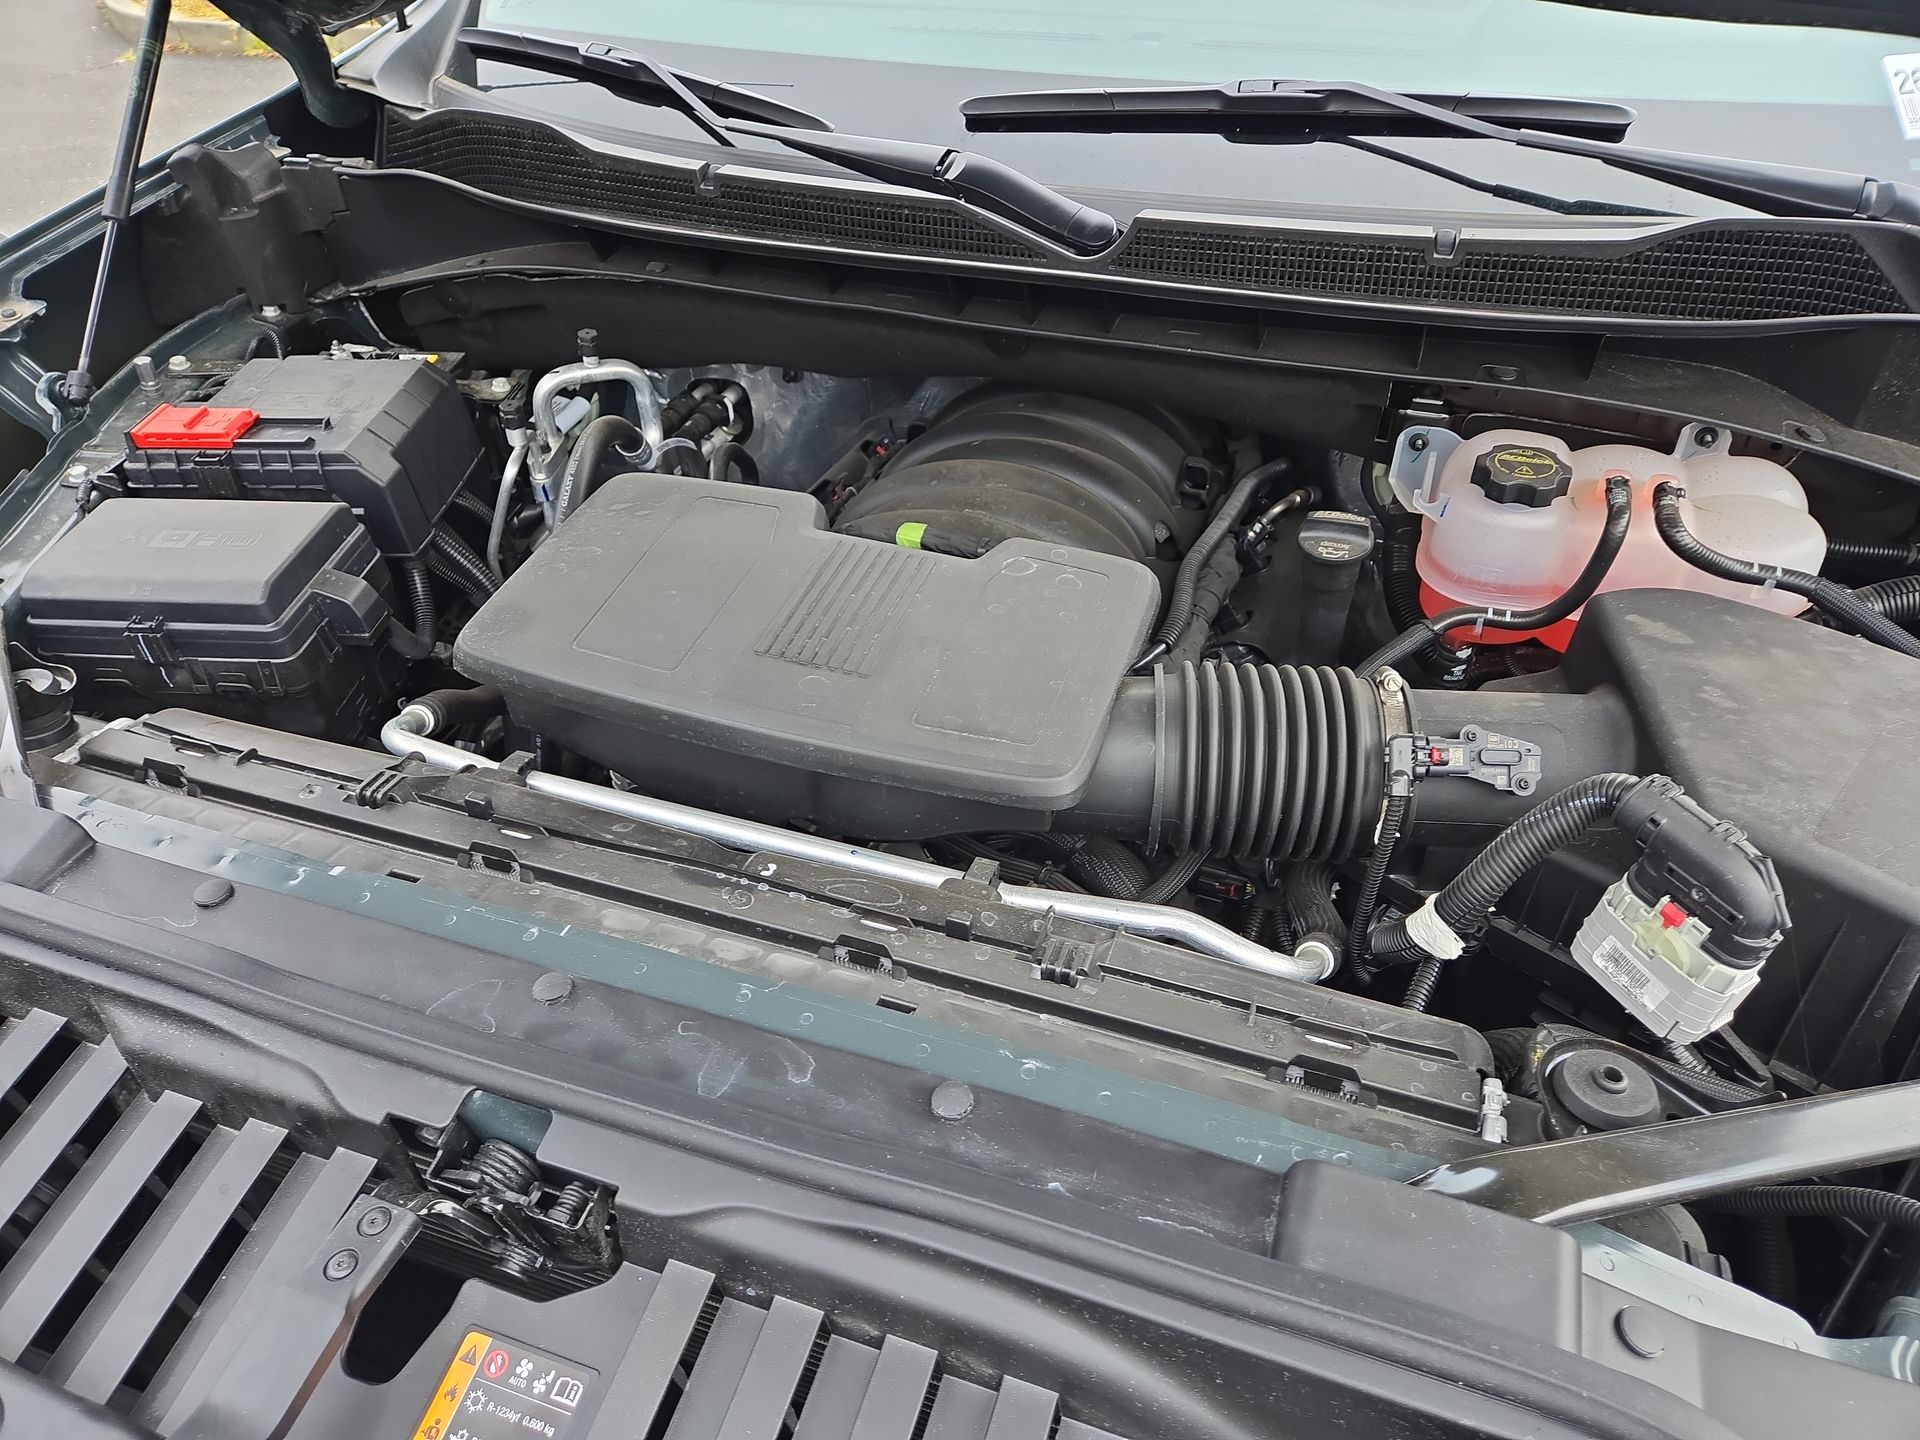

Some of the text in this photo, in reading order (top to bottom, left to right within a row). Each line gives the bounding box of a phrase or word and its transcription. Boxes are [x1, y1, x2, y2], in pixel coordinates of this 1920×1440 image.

[561, 475, 574, 507] GALAXY
[508, 1375, 528, 1389] AUTO
[487, 1403, 556, 1437] R-1234yf 0.600 kg
